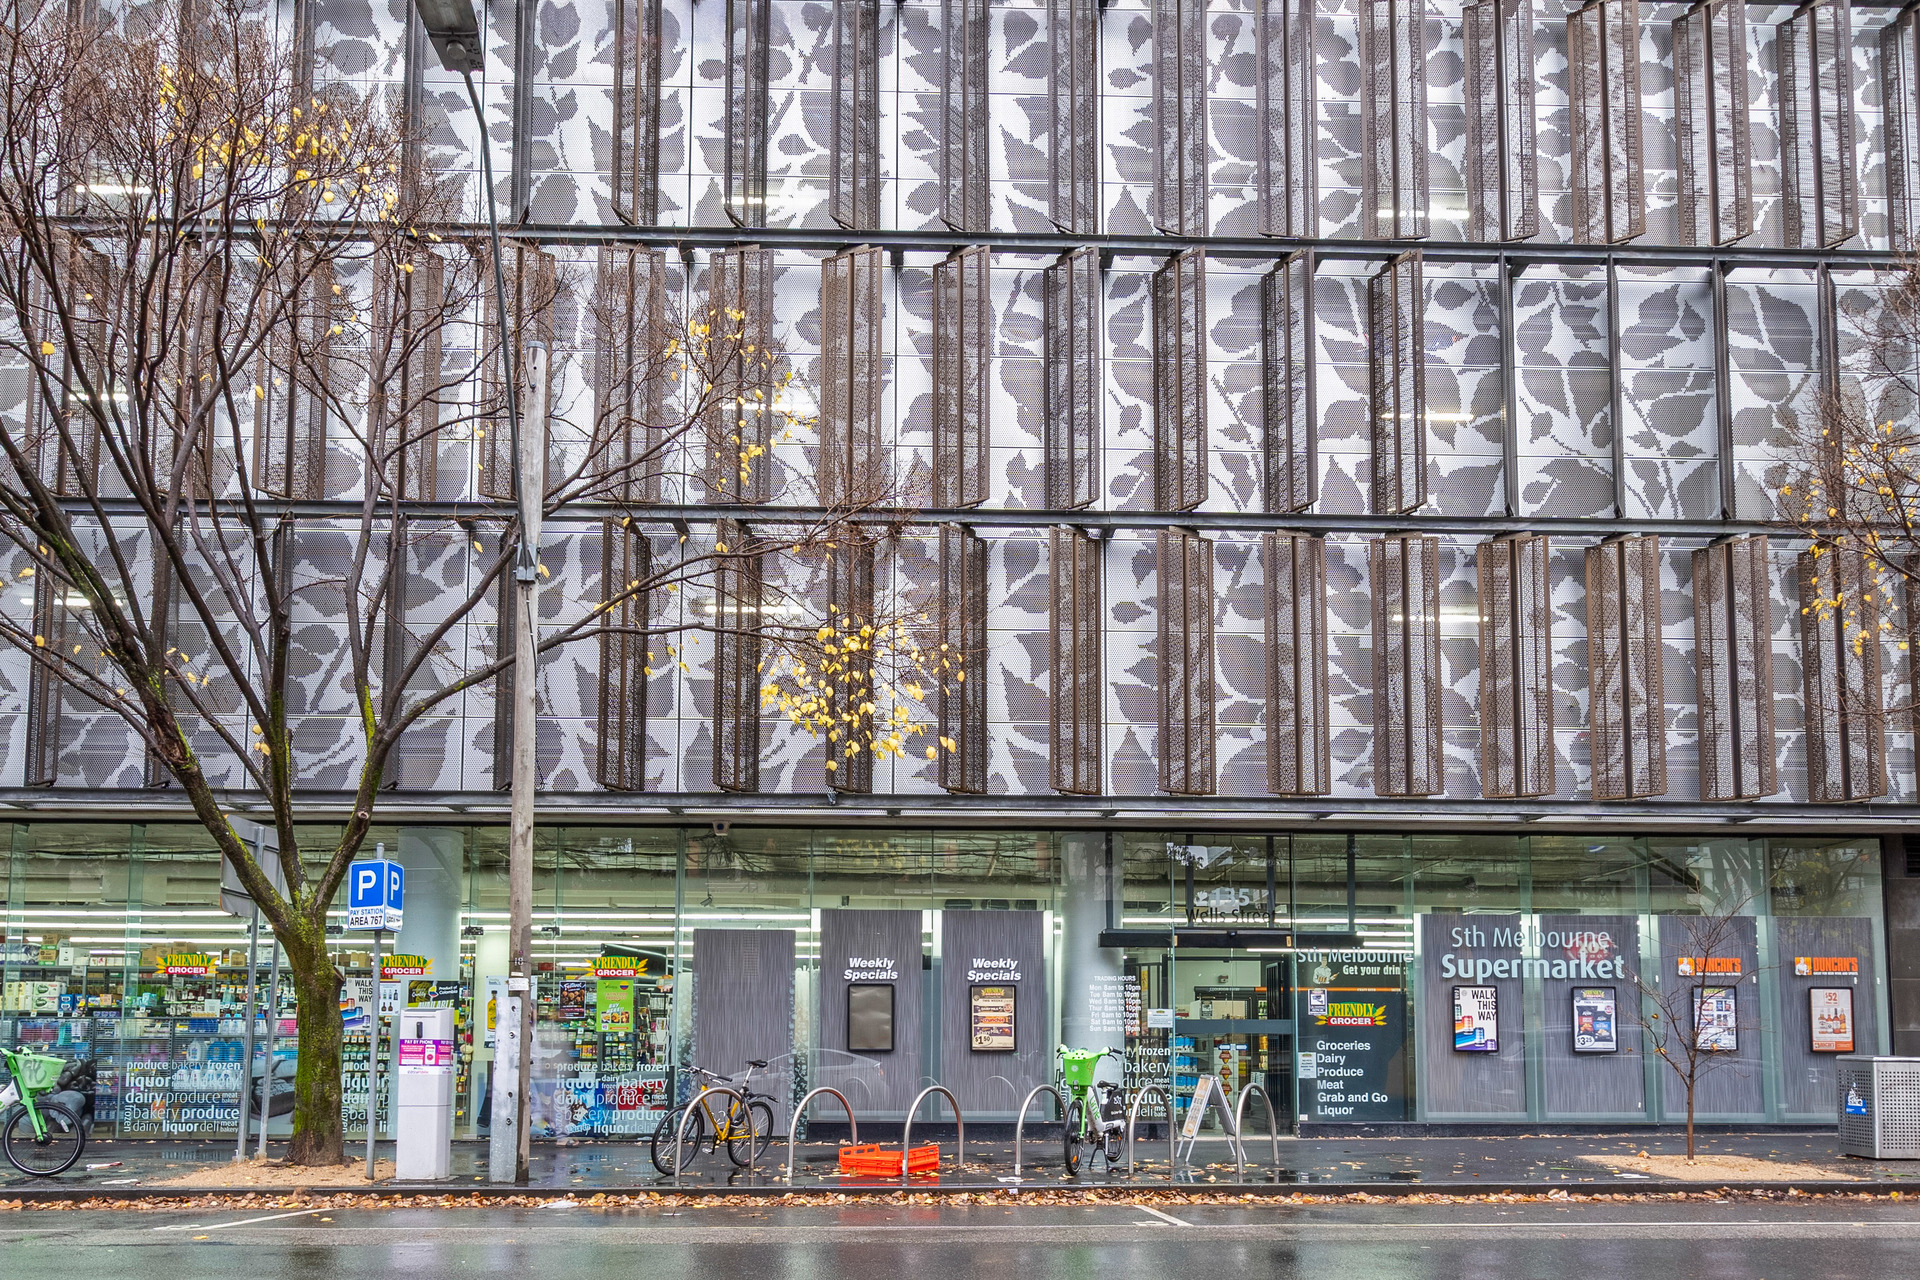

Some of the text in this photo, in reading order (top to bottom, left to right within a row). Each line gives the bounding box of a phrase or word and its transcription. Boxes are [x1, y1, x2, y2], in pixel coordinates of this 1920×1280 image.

[358, 870, 376, 900] P
[391, 871, 400, 900] P
[1211, 888, 1250, 906] 135
[350, 916, 368, 926] AREA
[371, 916, 382, 925] 767
[1186, 907, 1275, 923] Wells Street
[1451, 925, 1485, 948] Sth
[1493, 925, 1609, 948] Melbourne
[167, 954, 208, 966] FRIENDLY
[383, 955, 425, 967] FRIENDLY
[1298, 947, 1412, 963] Sth Melbourne
[596, 957, 638, 969] FRIENDLY
[849, 958, 894, 970] Weekly
[973, 958, 1018, 970] Weekly
[1441, 953, 1625, 984] Supermarket
[1813, 957, 1858, 972] DUNCAN'S
[168, 966, 205, 974] GROCER
[844, 969, 898, 982] Specials
[967, 970, 1021, 982] Specials
[1343, 965, 1358, 975] Get
[1360, 966, 1380, 976] your
[1472, 990, 1496, 999] WALK
[1825, 992, 1838, 1001] $52
[1328, 1004, 1374, 1016] FRIENDLY
[1478, 1001, 1496, 1010] THIS
[1478, 1011, 1496, 1020] WAY
[1139, 1045, 1170, 1056] frozen
[1316, 1040, 1371, 1050] Groceries
[1317, 1054, 1346, 1065] Dairy
[126, 1060, 240, 1072] produce bakery frozen
[557, 1061, 669, 1073] produce bakery frozen
[1124, 1059, 1170, 1076] bakery
[1317, 1067, 1364, 1076] Produce
[126, 1072, 171, 1090] liquor
[556, 1074, 600, 1092] liquor
[602, 1075, 620, 1083] dairy
[622, 1075, 668, 1092] bakery
[1317, 1080, 1344, 1089] Meat
[126, 1089, 220, 1106] dairy produce
[597, 1092, 650, 1108] produce
[1318, 1092, 1388, 1102] Grab and Go
[133, 1104, 240, 1122] bakery produce
[1318, 1105, 1354, 1117] Liquor
[133, 1120, 220, 1134] dairy liquor deli
[594, 1122, 630, 1136] liquor
